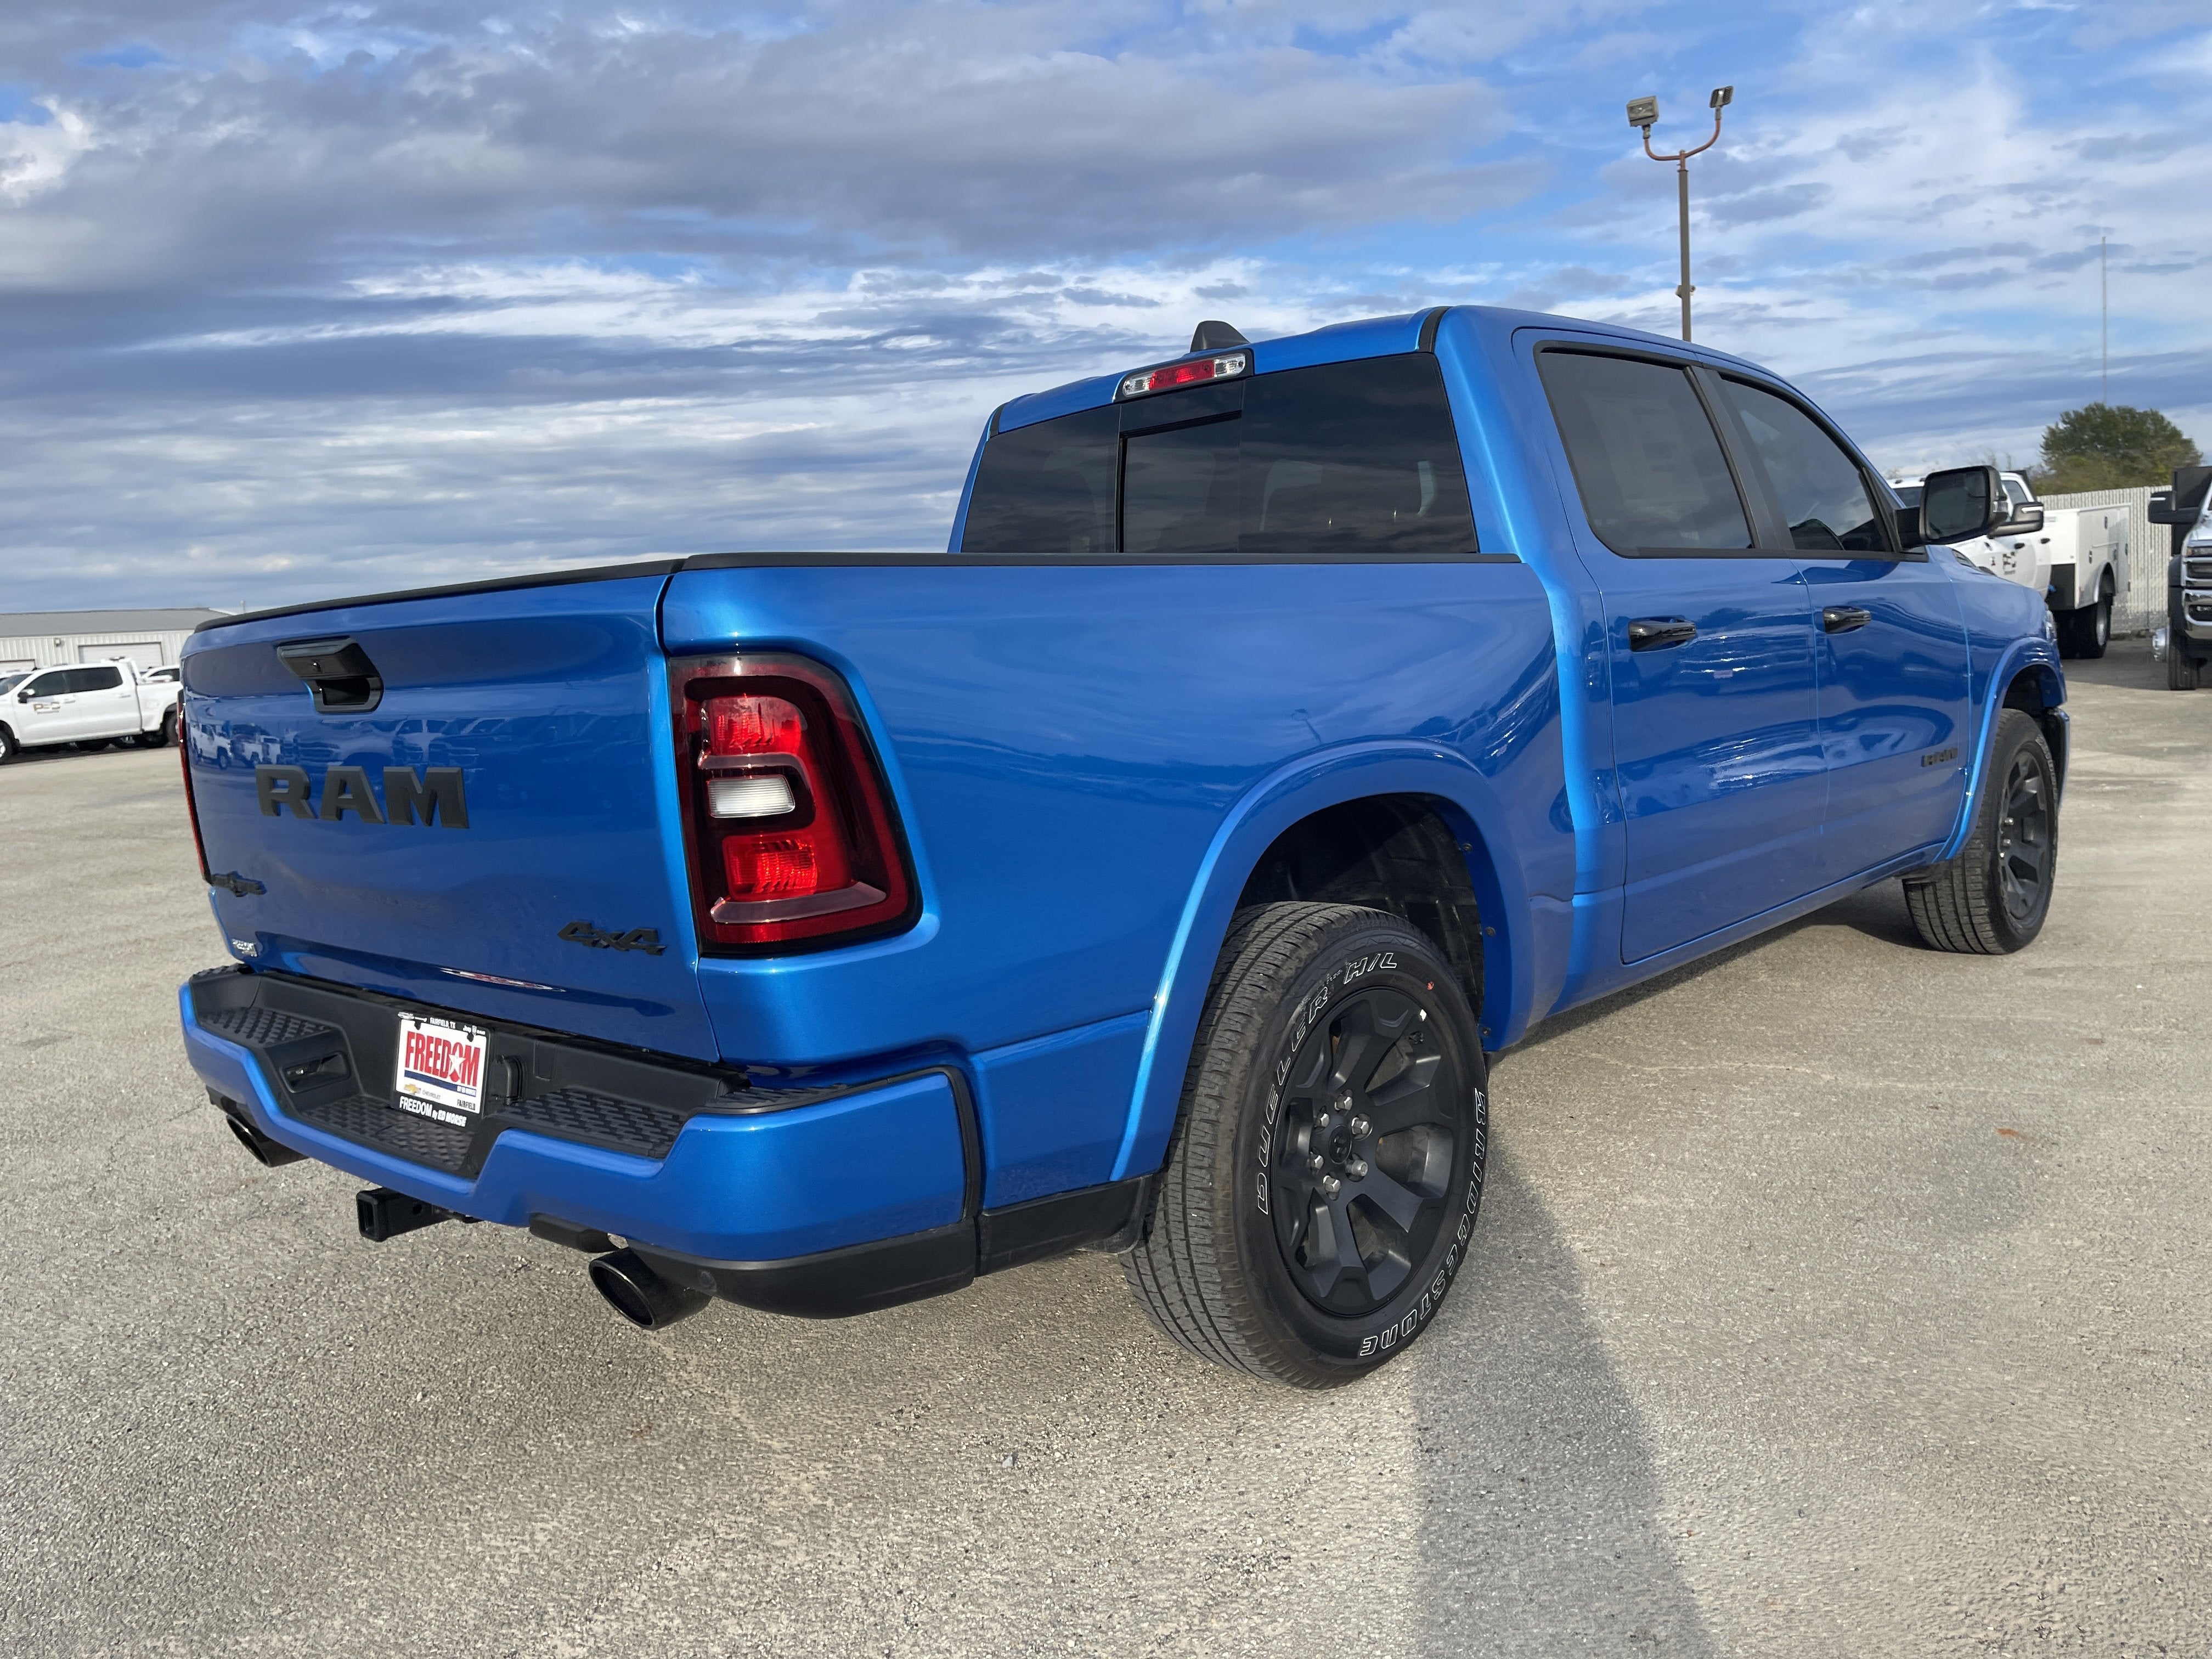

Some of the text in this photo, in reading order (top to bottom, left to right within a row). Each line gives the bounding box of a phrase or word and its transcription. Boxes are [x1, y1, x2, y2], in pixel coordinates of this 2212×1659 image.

[256, 764, 469, 828] RAM
[450, 1021, 456, 1030] TX
[405, 1031, 481, 1087] FREEDOM
[422, 1090, 441, 1099] CHEVROLET
[457, 1099, 476, 1111] FAIRFIELD
[1257, 952, 1397, 1215] DUELER H/L
[399, 1096, 432, 1117] FREEDOM
[437, 1110, 446, 1121] ED
[445, 1112, 467, 1127] MORSE
[1359, 1087, 1486, 1356] BRIDGESTONE
